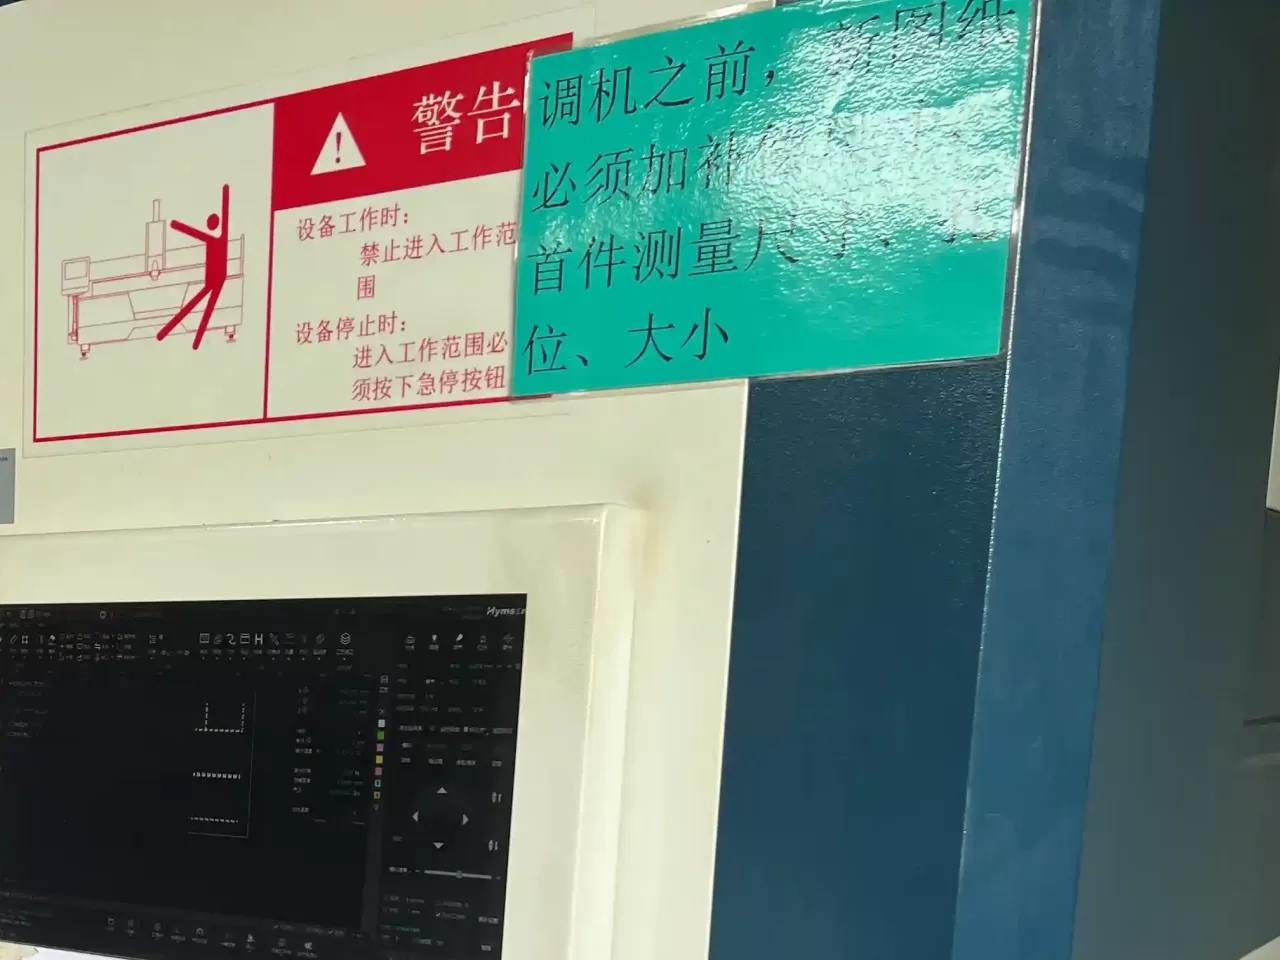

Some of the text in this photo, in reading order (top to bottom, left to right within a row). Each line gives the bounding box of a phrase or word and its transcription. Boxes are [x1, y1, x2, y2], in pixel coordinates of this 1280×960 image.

[412, 81, 521, 155] 警告
[297, 203, 410, 242] 设备工作时：
[359, 222, 517, 267] 禁止进入工作范
[357, 275, 376, 301] 围
[295, 310, 407, 345] 设备停止时：
[522, 307, 729, 377] 位、大小
[352, 331, 508, 370] 进入工作范围必
[351, 364, 506, 402] 须按下急停按钮
